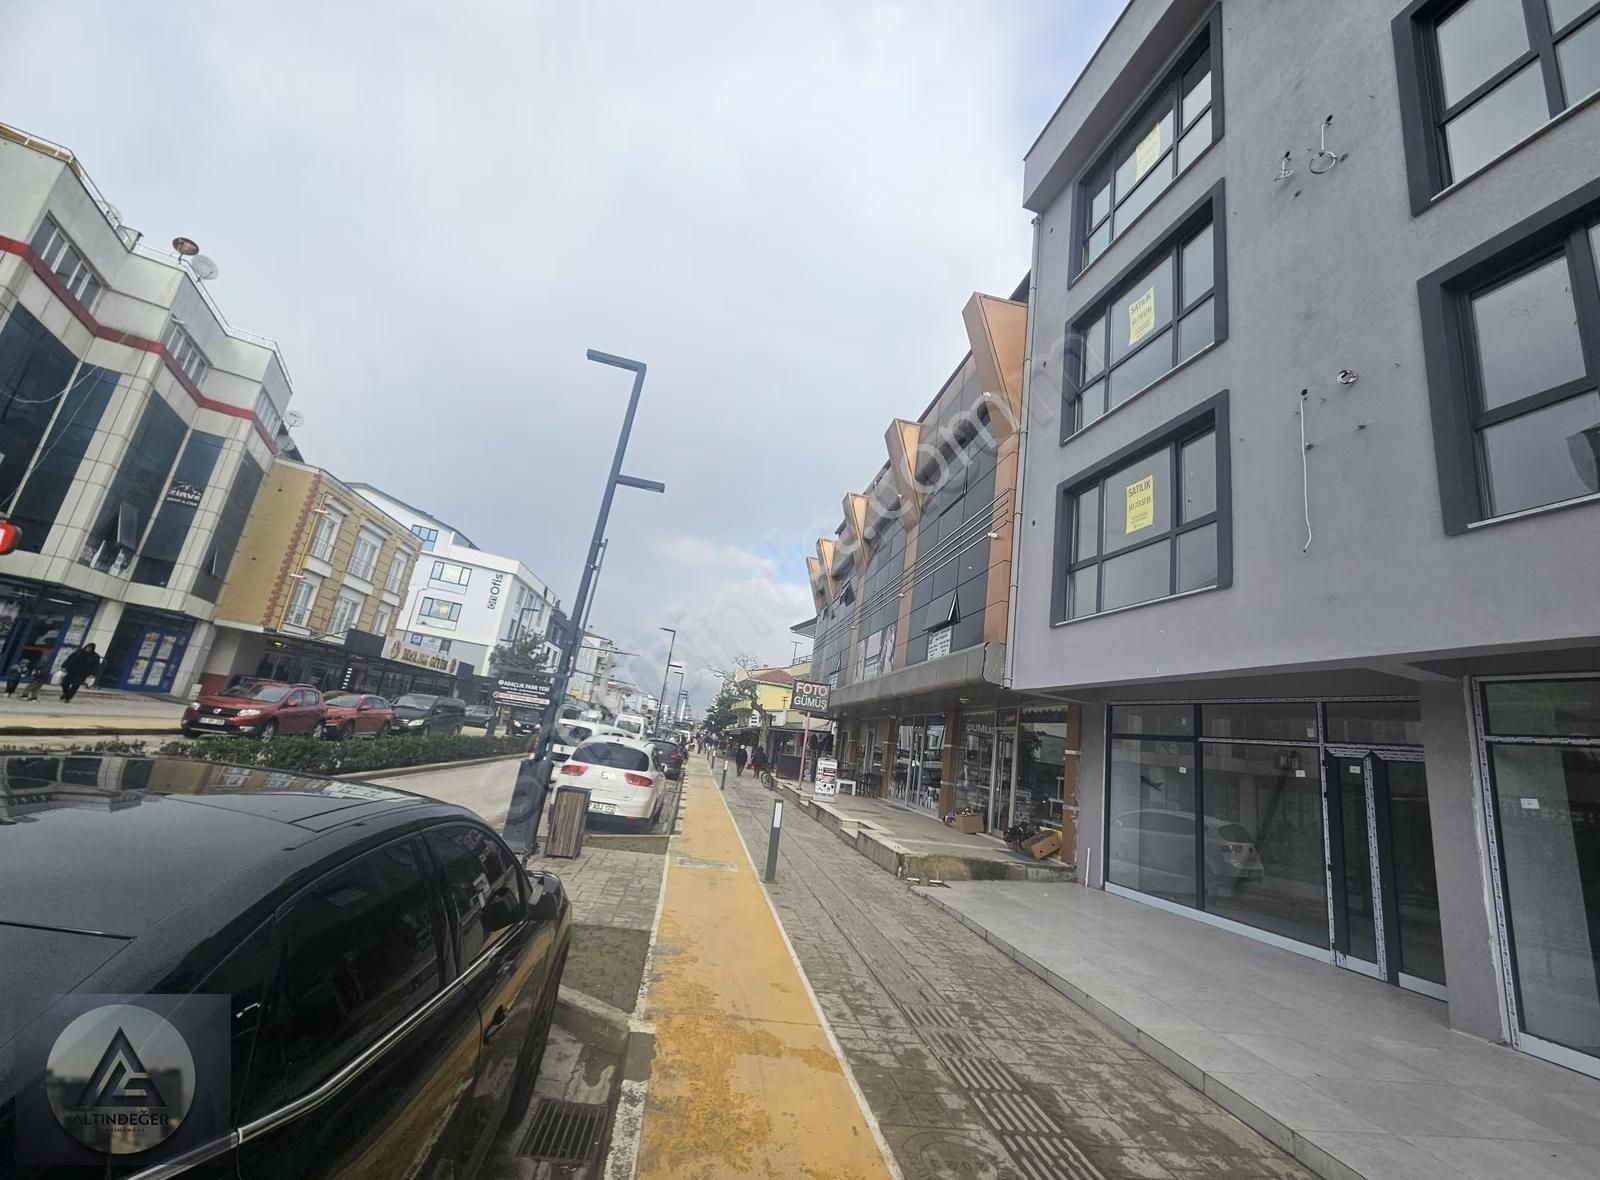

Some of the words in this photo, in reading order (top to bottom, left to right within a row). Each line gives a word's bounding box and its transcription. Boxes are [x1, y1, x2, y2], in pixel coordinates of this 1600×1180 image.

[1128, 480, 1151, 497] SATILIK
[796, 682, 828, 697] FOTO
[794, 695, 828, 711] GÜMÜŞ
